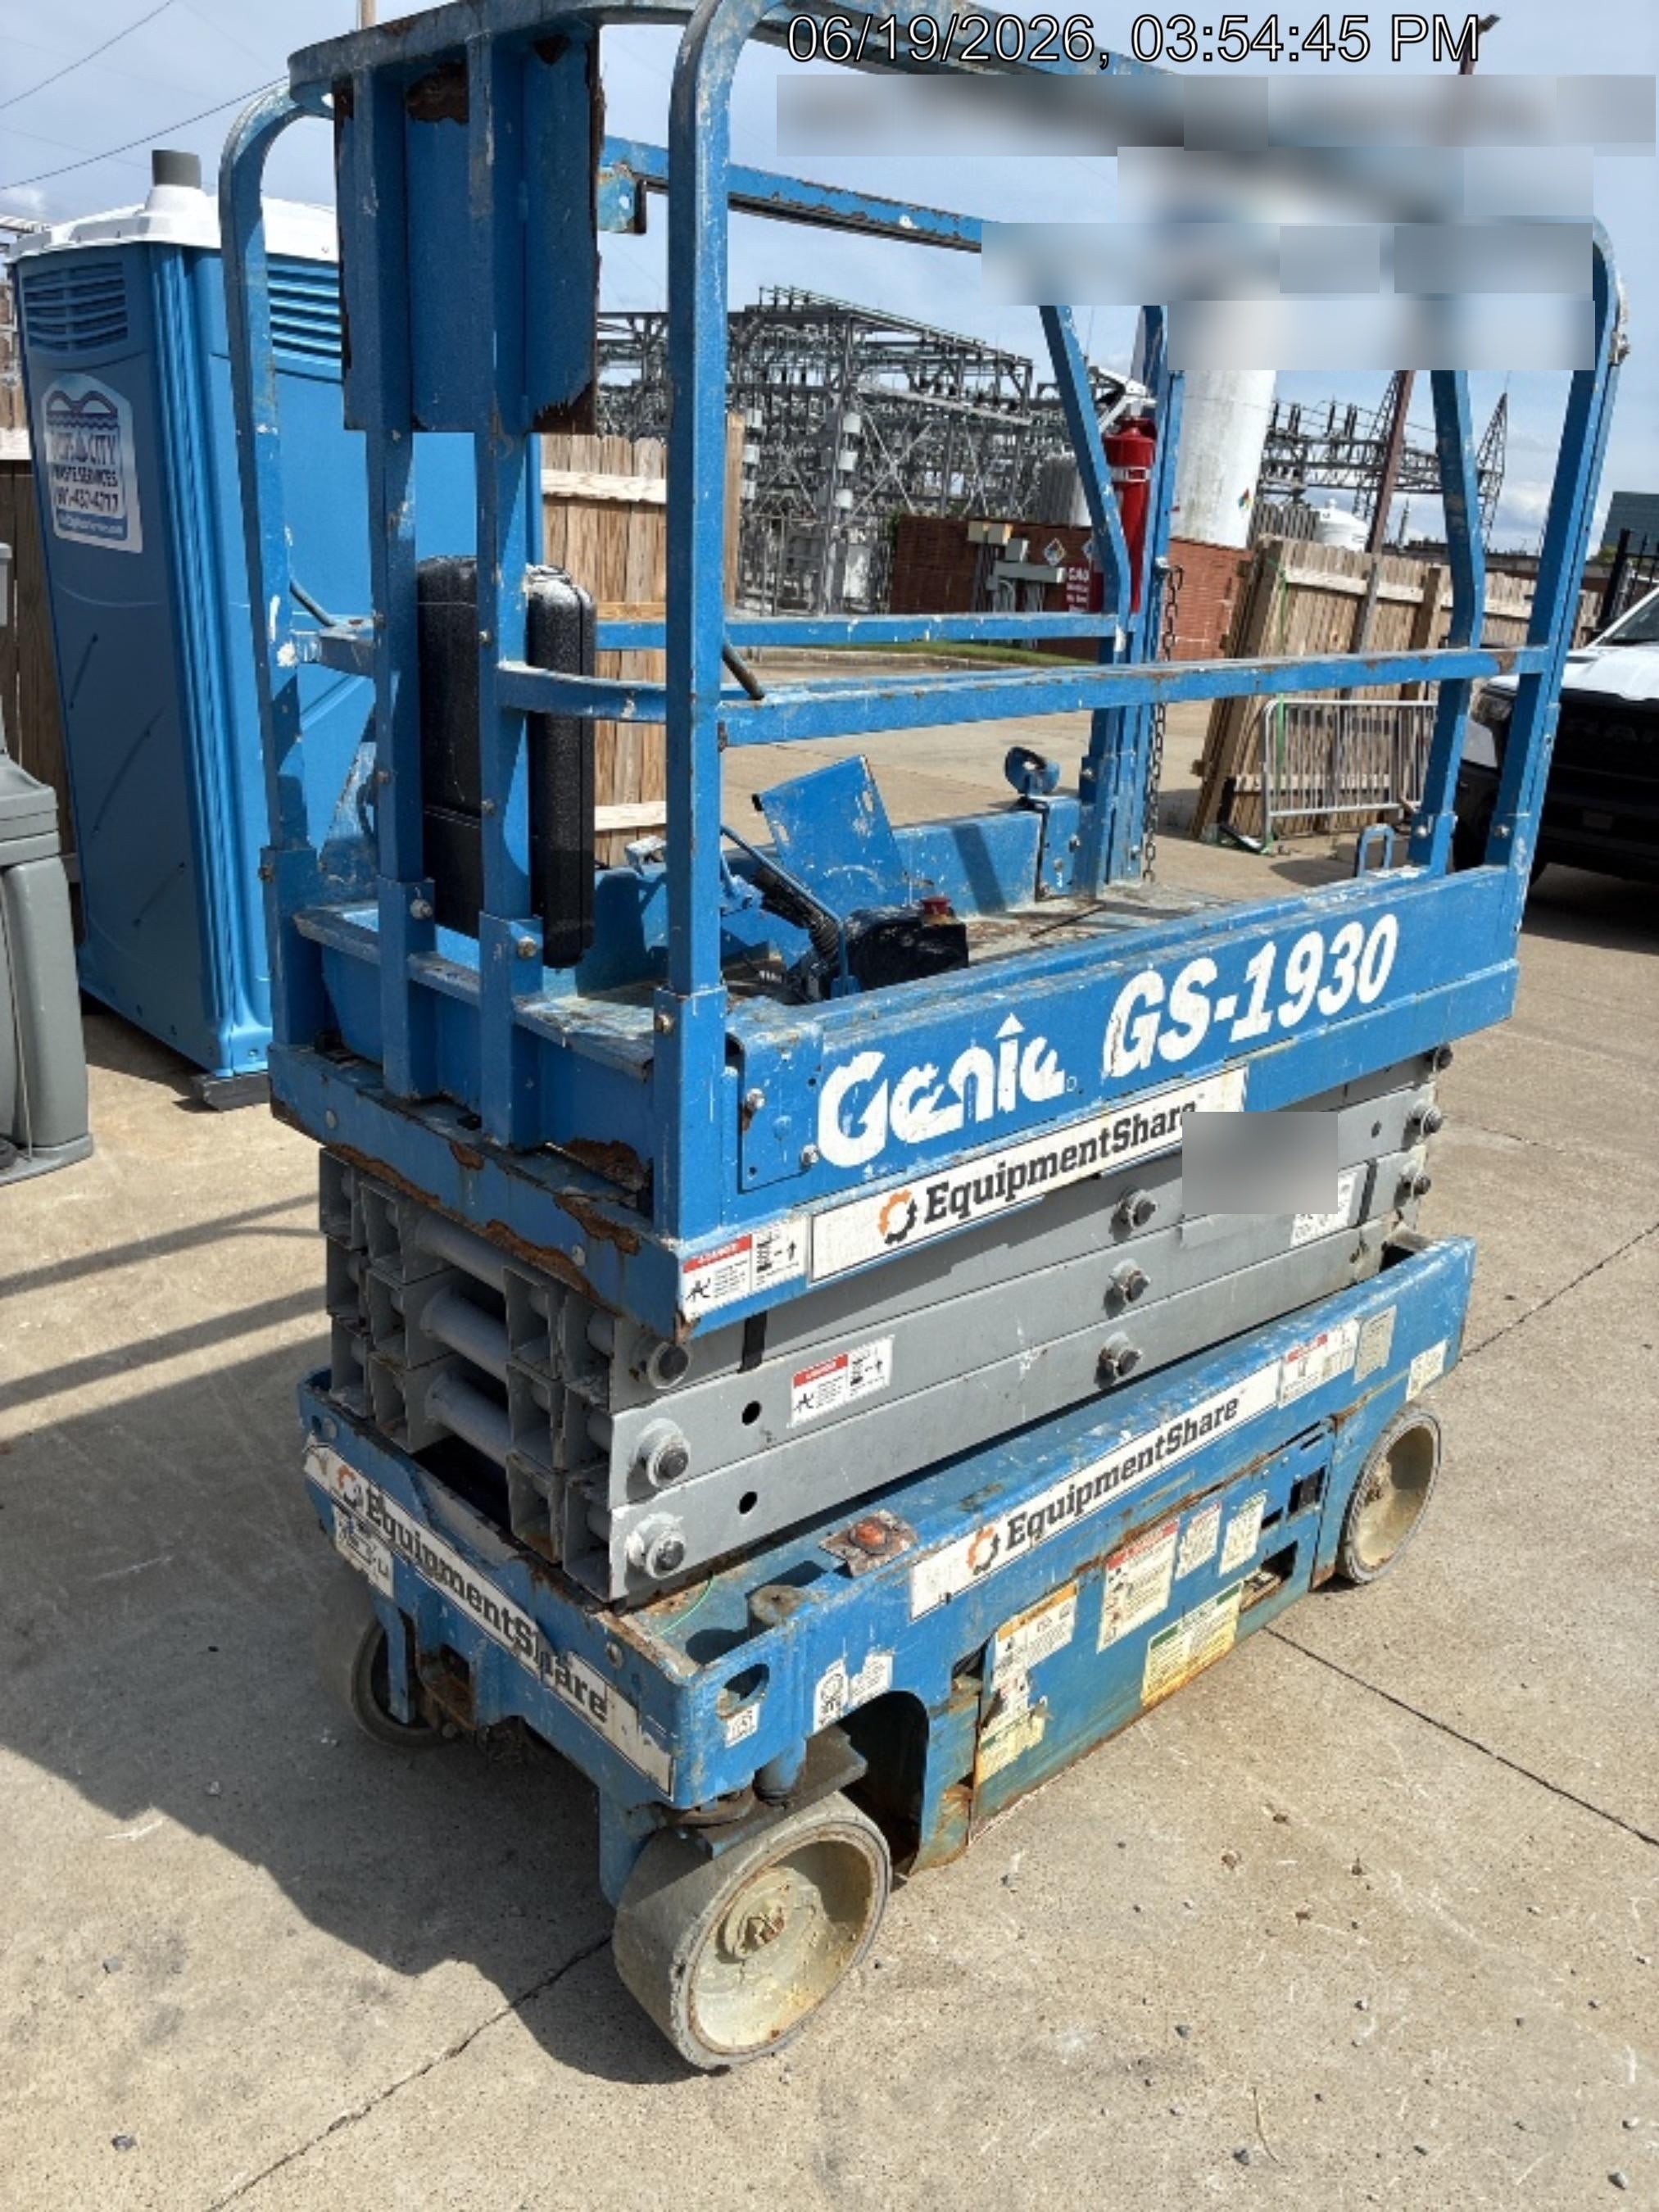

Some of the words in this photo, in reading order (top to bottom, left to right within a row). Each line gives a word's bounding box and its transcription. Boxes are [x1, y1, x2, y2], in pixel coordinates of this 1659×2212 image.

[818, 1013, 1065, 1167] Genie
[1102, 913, 1399, 1077] GS-1930
[1006, 1398, 1240, 1551] EquipmentShare
